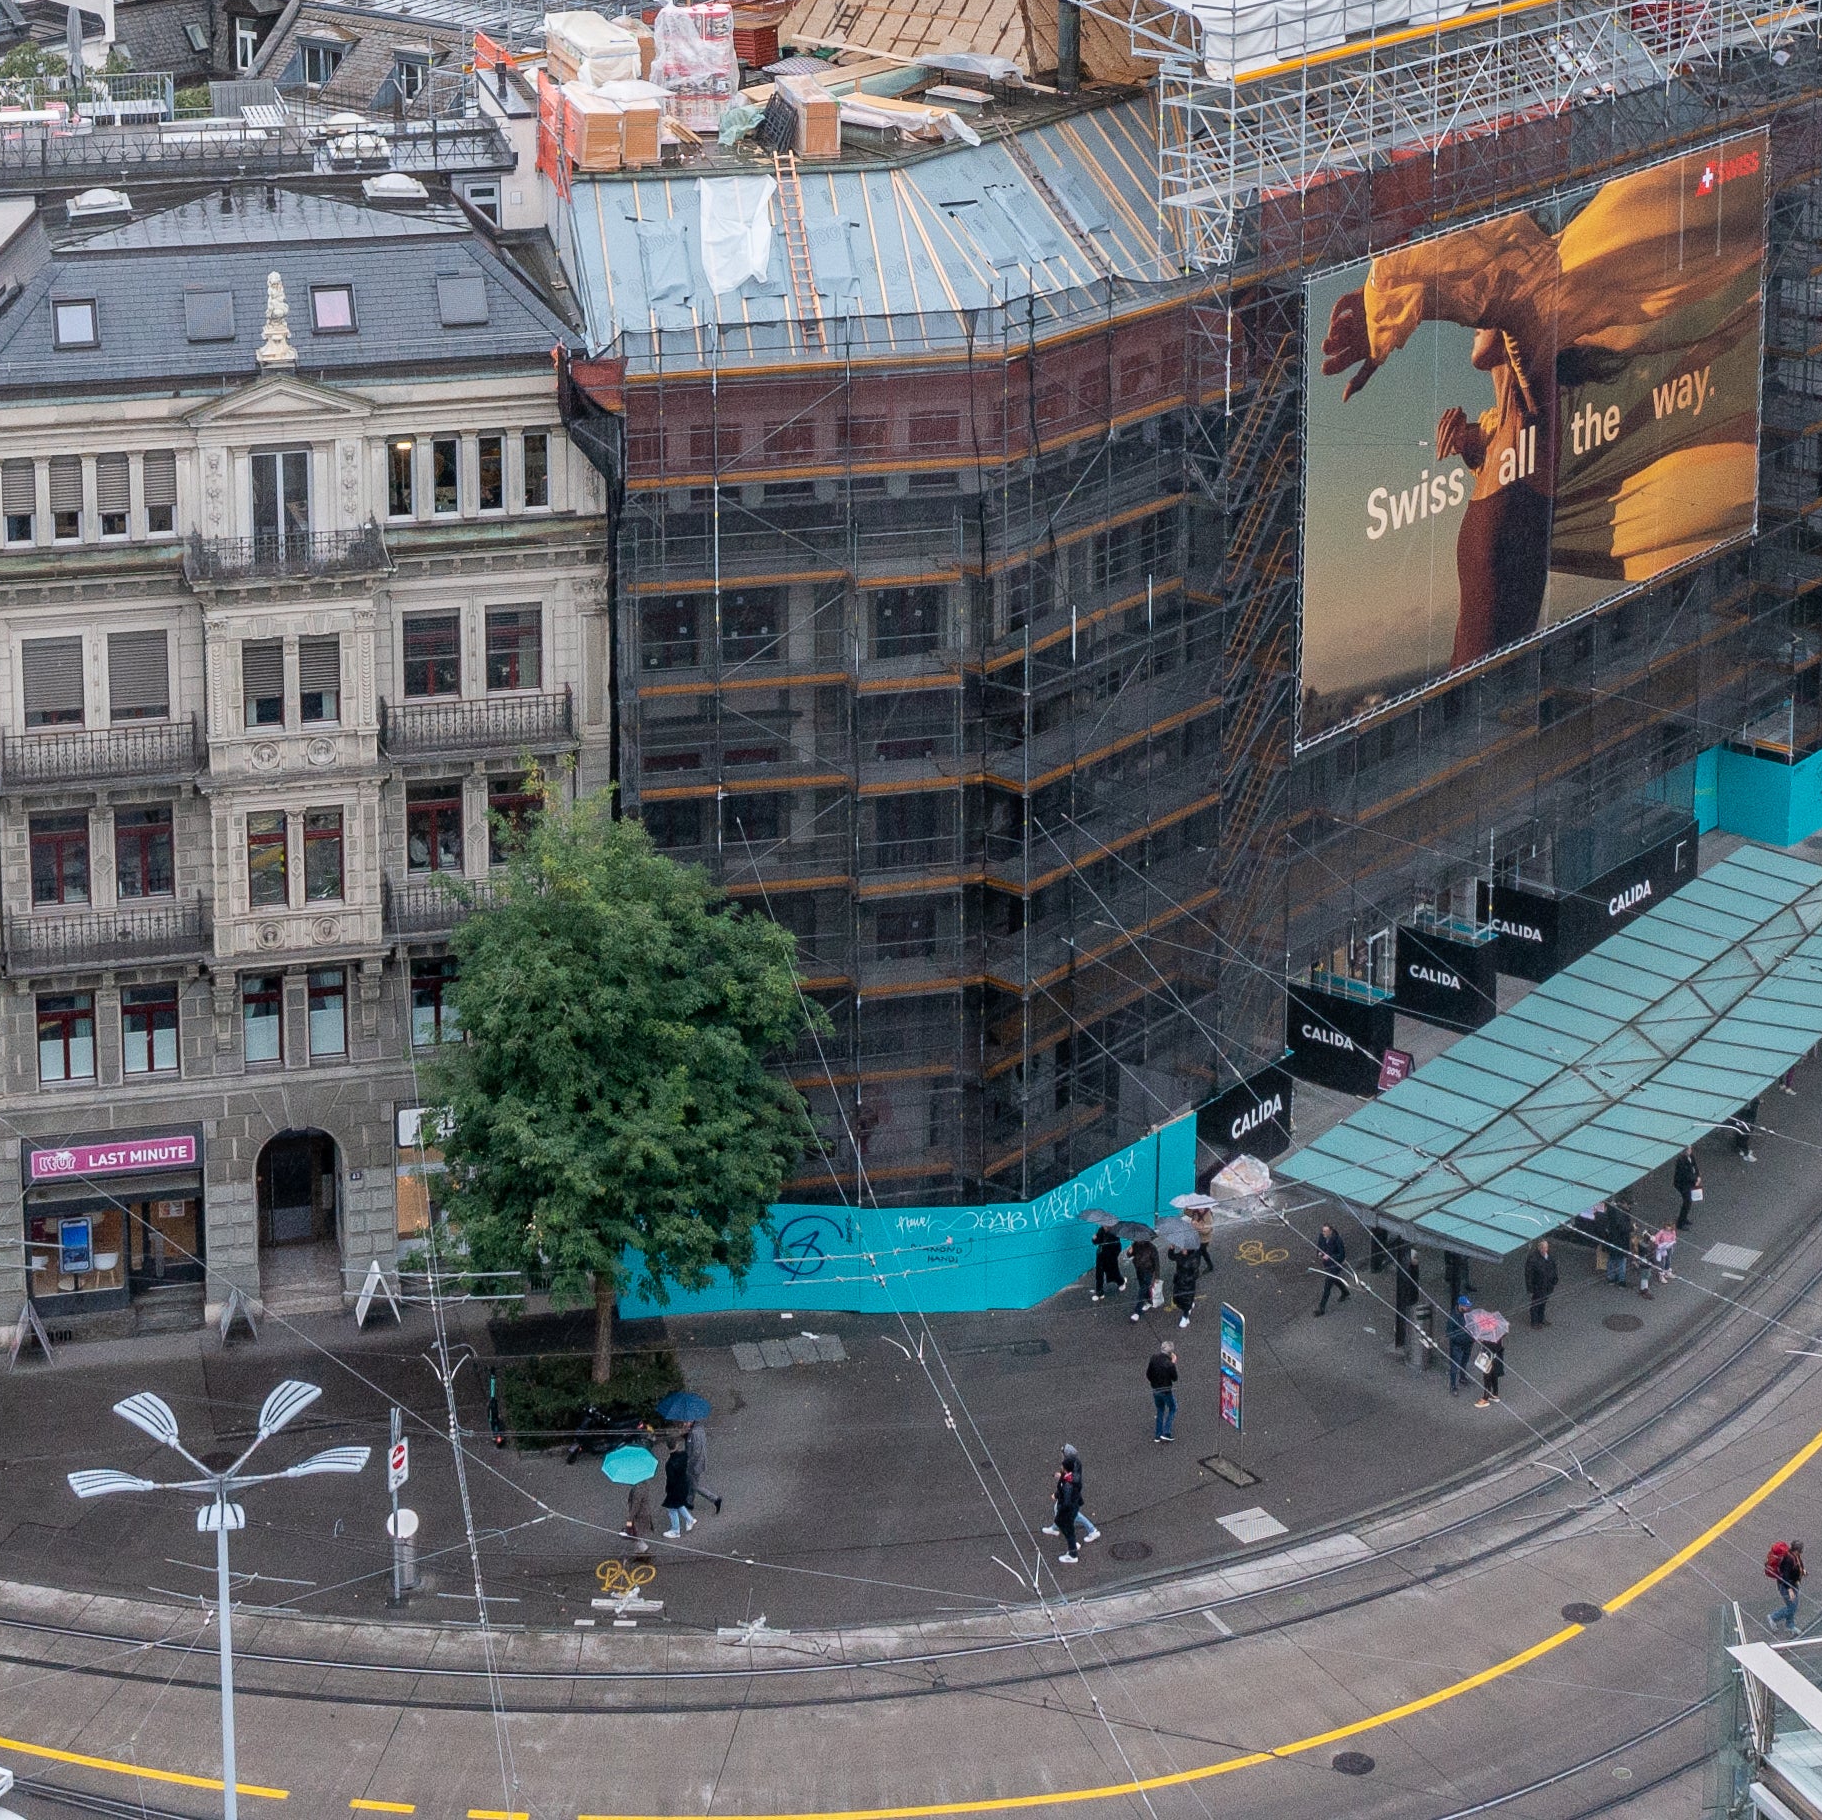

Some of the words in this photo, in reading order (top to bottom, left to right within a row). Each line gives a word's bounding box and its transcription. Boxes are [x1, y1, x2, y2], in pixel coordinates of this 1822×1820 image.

[1365, 466, 1465, 541] Swiss
[1498, 425, 1537, 486] all
[1570, 401, 1622, 456] the
[1652, 365, 1716, 421] way.
[1608, 879, 1652, 917] CALIDA
[1491, 918, 1543, 943] CALIDA
[1409, 963, 1461, 991] CALIDA
[1301, 1023, 1354, 1052] CALIDA
[1231, 1093, 1282, 1141] CALIDA
[88, 1151, 127, 1168] LAST
[130, 1145, 188, 1164] MINUTE
